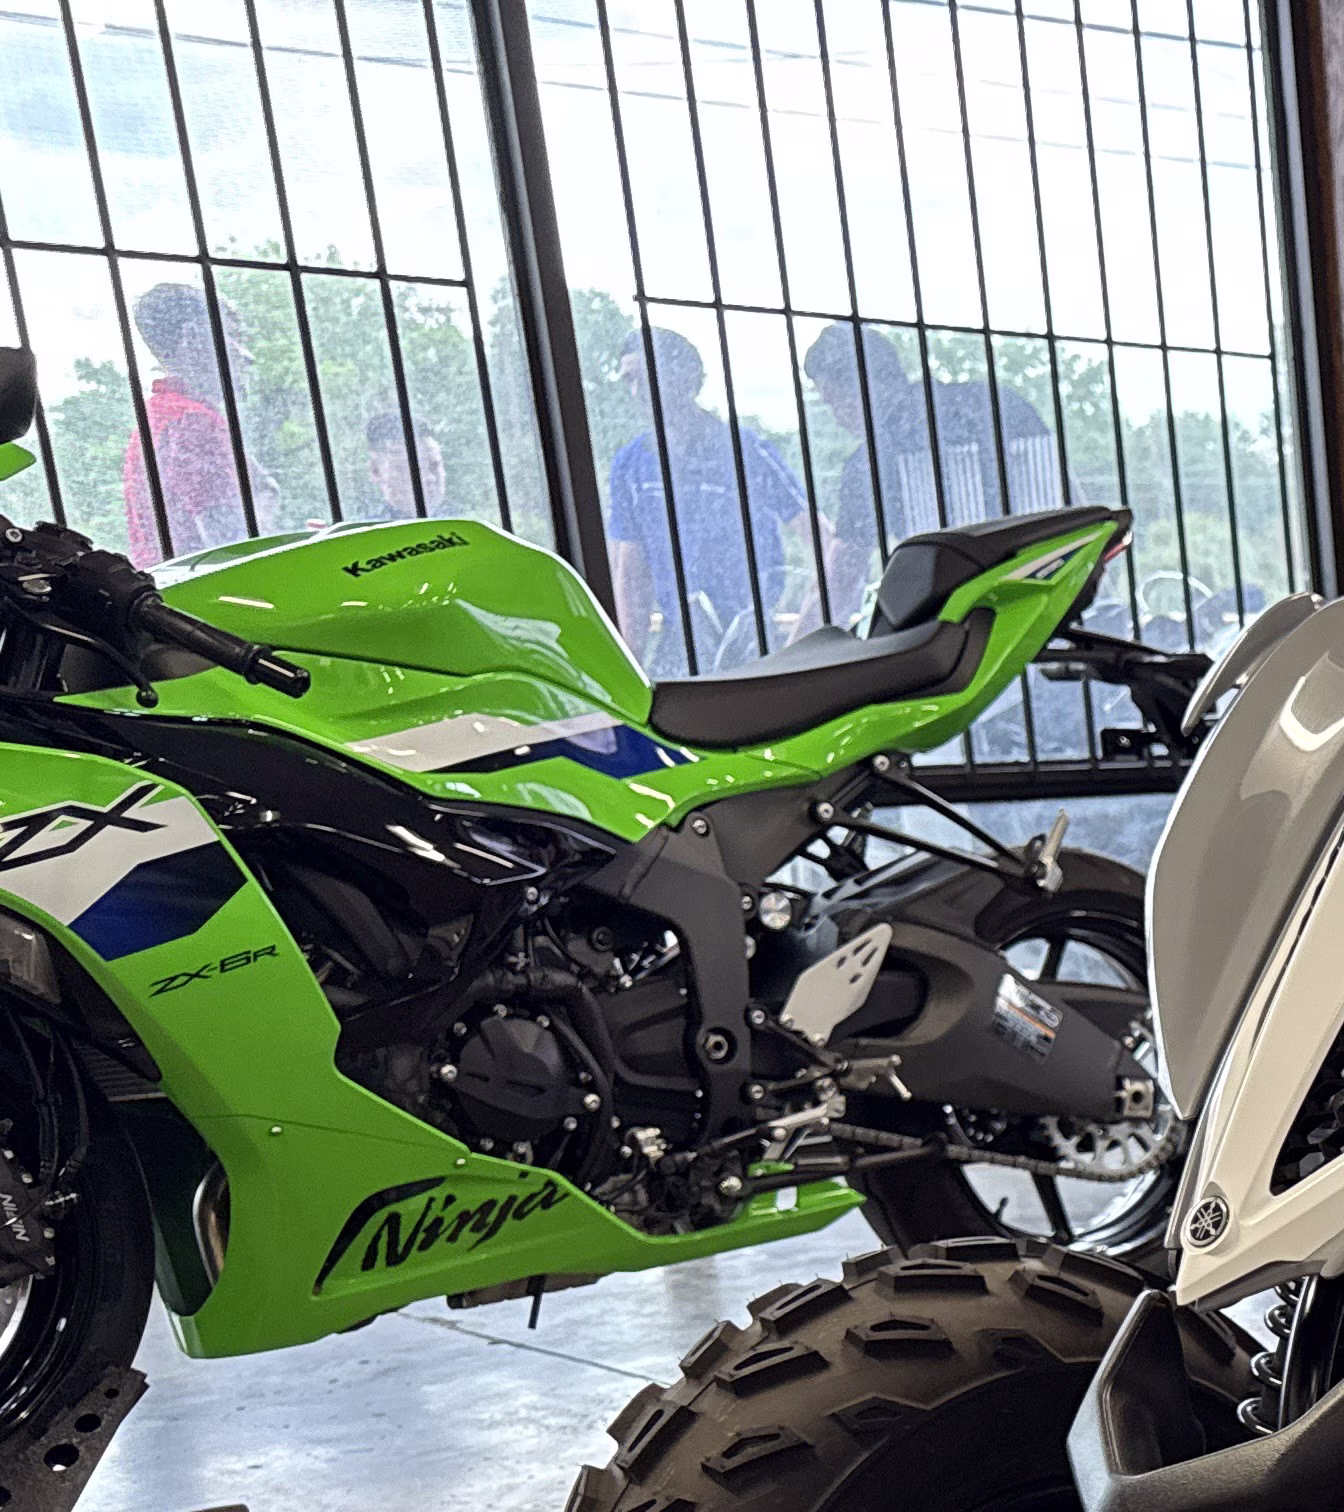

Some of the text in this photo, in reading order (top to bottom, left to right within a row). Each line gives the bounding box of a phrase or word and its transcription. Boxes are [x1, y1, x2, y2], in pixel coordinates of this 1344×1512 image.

[341, 531, 470, 578] Kawasaki
[148, 944, 279, 998] ZX-6R
[360, 1171, 571, 1271] Ninja
